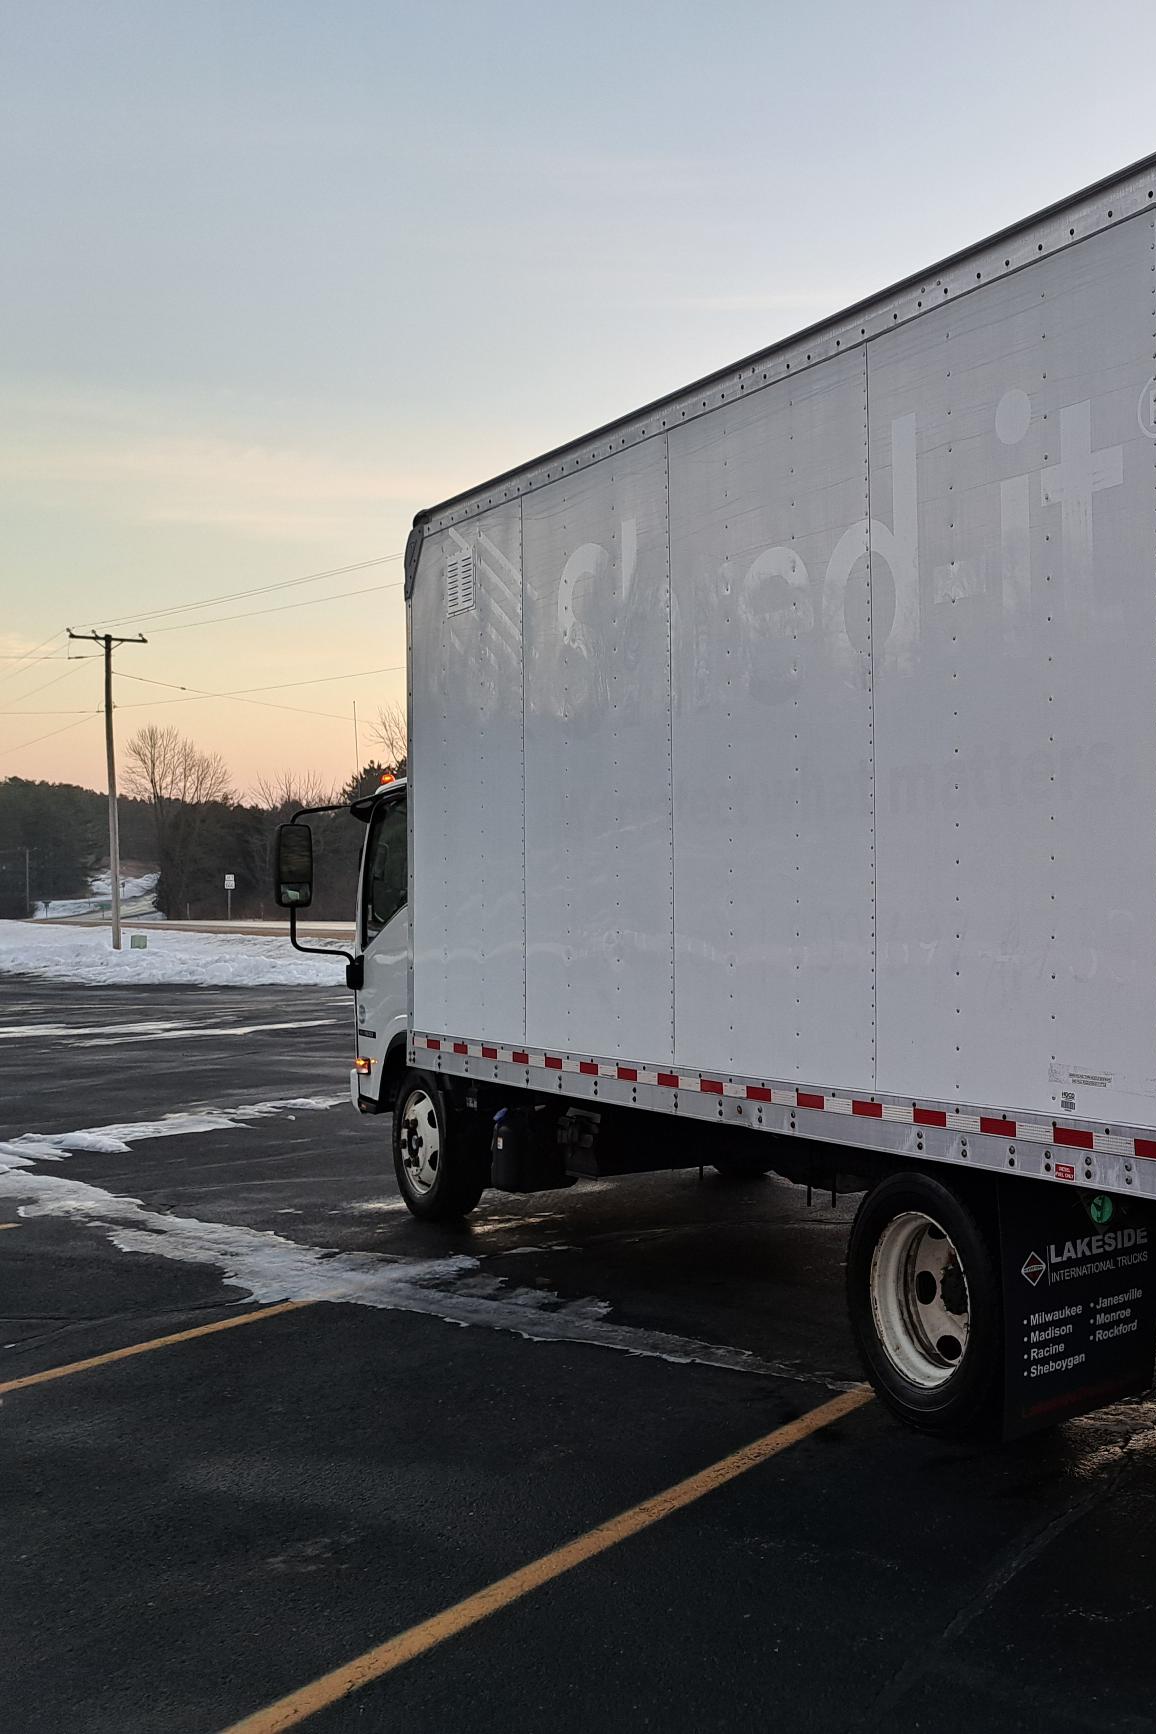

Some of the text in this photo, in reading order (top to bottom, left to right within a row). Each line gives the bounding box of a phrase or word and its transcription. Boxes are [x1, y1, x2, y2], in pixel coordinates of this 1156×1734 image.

[1049, 1227, 1148, 1263] LAKESIDE
[1051, 1260, 1116, 1283] INTERNATIONAL
[1116, 1251, 1148, 1268] TRUCKS
[1096, 1288, 1143, 1309] Janesville
[1030, 1304, 1083, 1327] Milwaukee
[1096, 1308, 1131, 1326] Monroe
[1030, 1323, 1073, 1344] Madison
[1095, 1320, 1138, 1343] Rockford
[1030, 1342, 1065, 1361] Racine
[1030, 1352, 1086, 1378] Sheboygan
